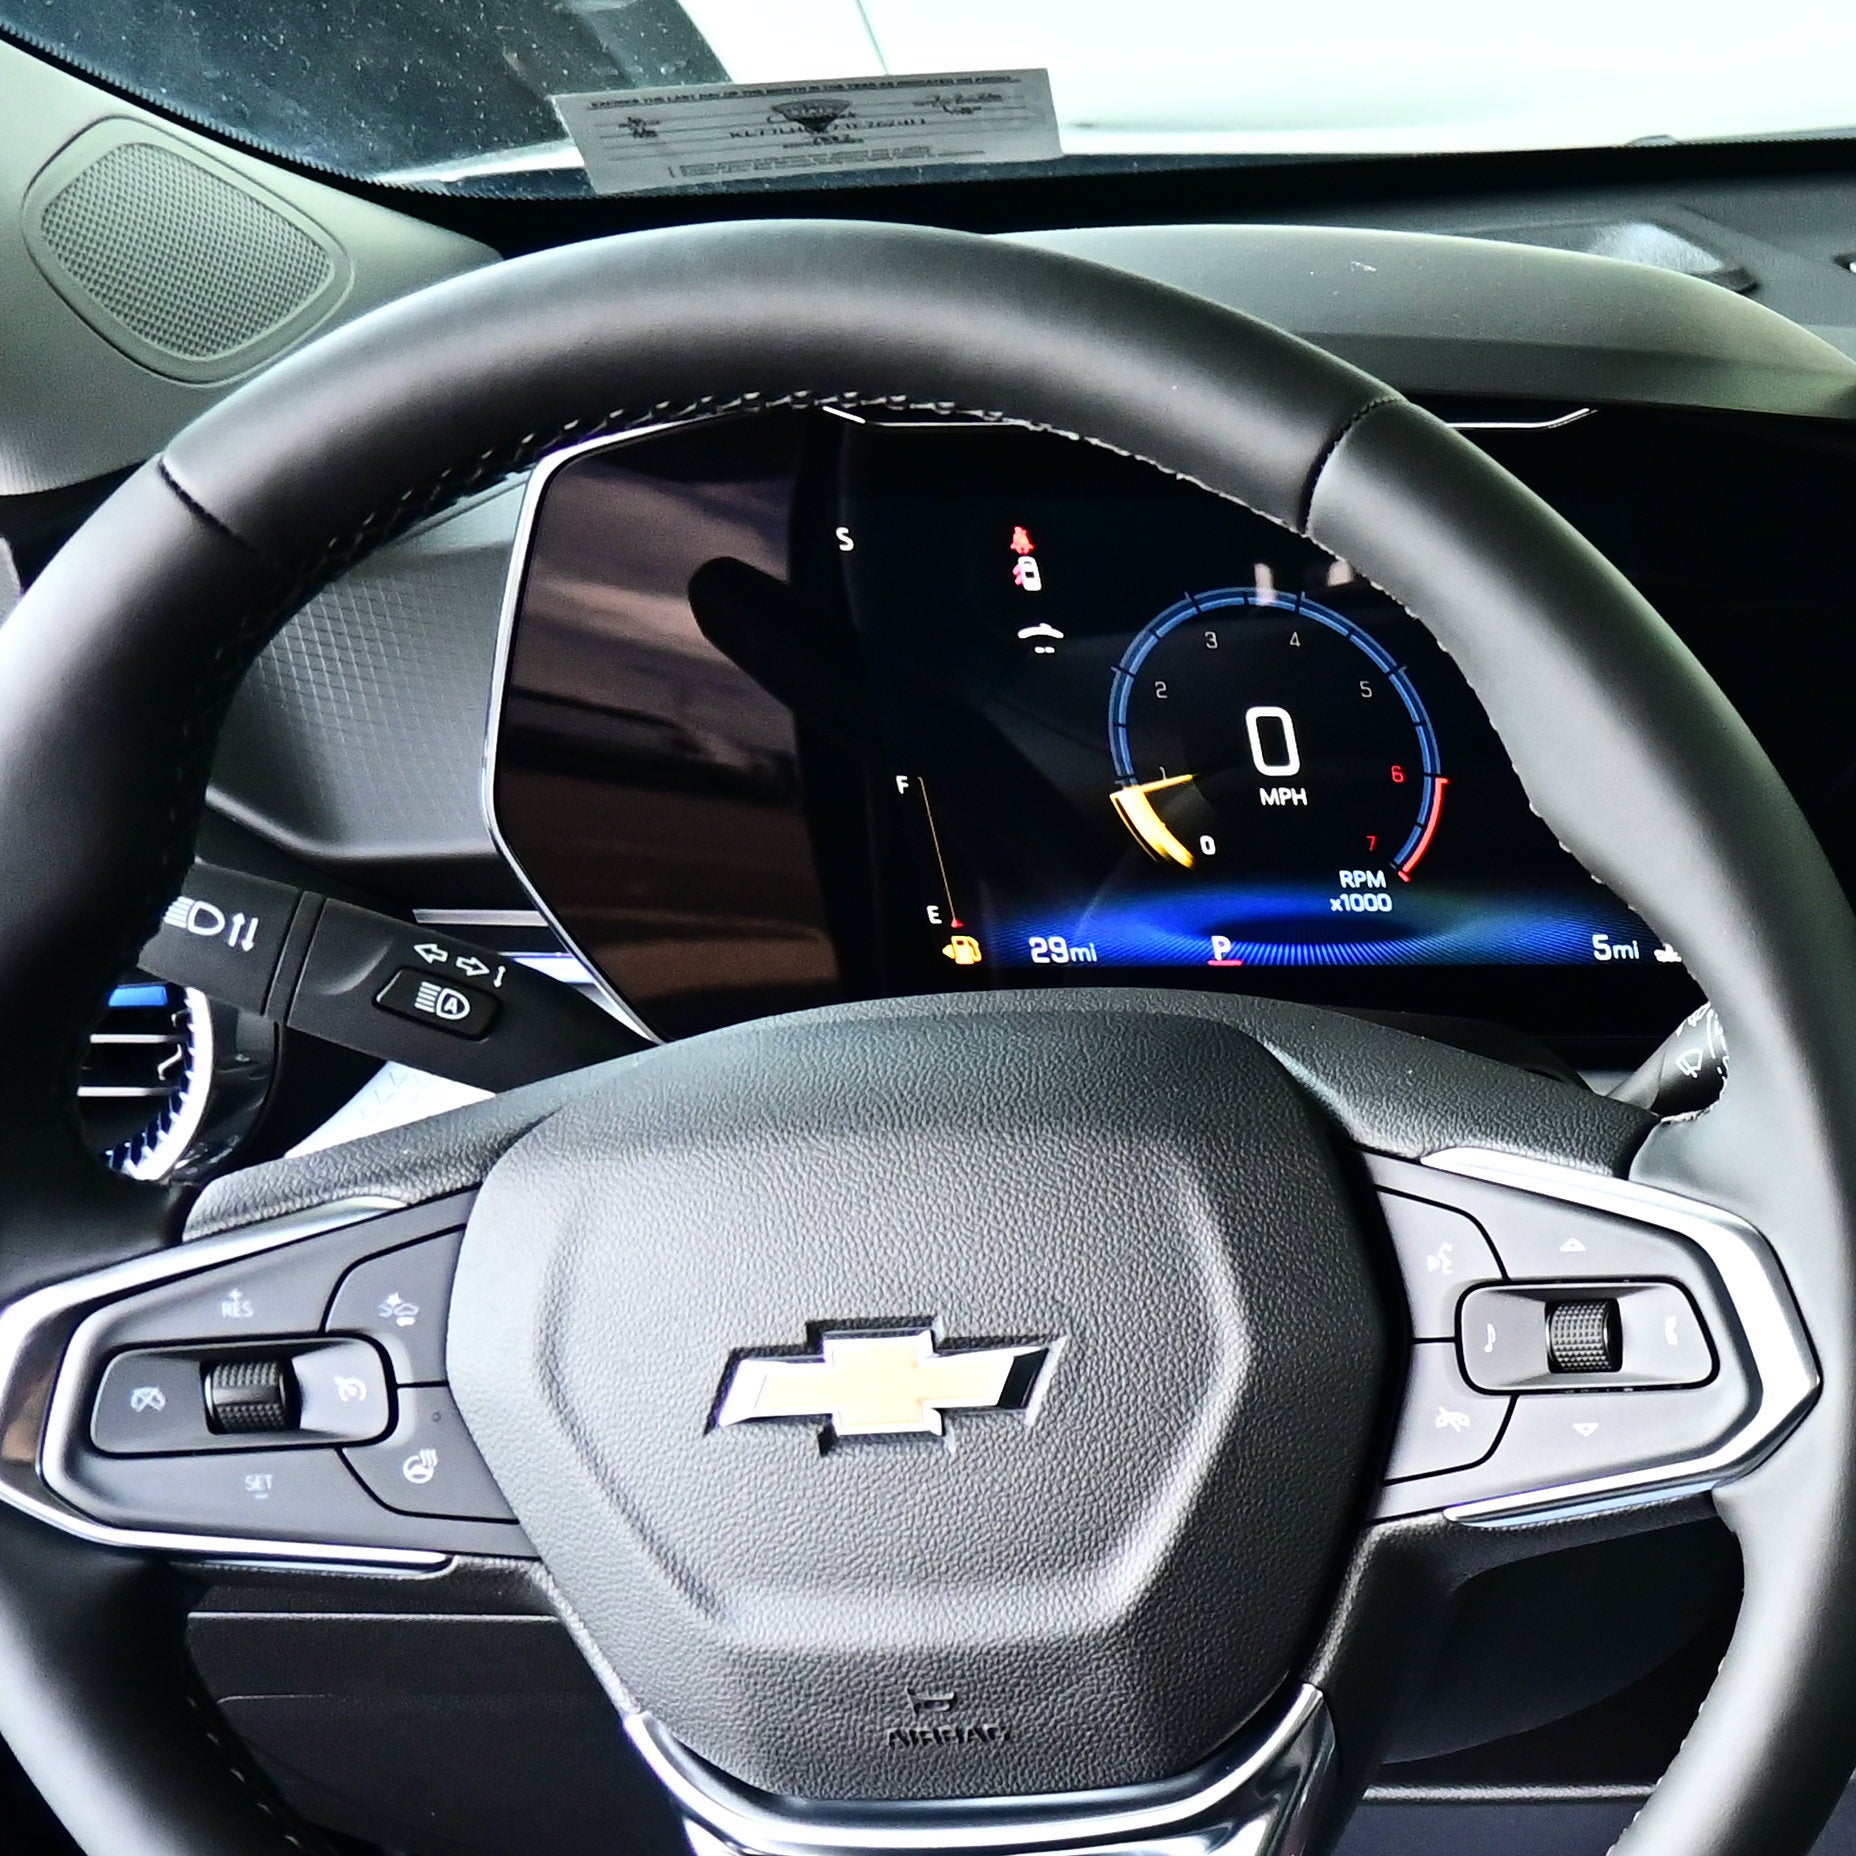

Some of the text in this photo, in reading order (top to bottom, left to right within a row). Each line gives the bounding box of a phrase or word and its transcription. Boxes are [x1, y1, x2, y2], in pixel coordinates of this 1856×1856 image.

[836, 527, 854, 551] S
[1205, 632, 1217, 648] 3
[1290, 632, 1300, 646] 4
[1155, 682, 1167, 698] 2
[1360, 681, 1372, 697] 5
[1246, 707, 1300, 776] 0
[1392, 766, 1404, 782] 6
[896, 776, 908, 794] F
[1260, 788, 1307, 805] MPH
[1200, 836, 1215, 855] 0
[1367, 836, 1376, 850] 7
[1339, 870, 1386, 888] RPM
[1329, 893, 1393, 913] x1000
[927, 906, 942, 924] E
[1211, 935, 1232, 960] P
[221, 1300, 254, 1318] RES
[244, 1474, 273, 1491] SET
